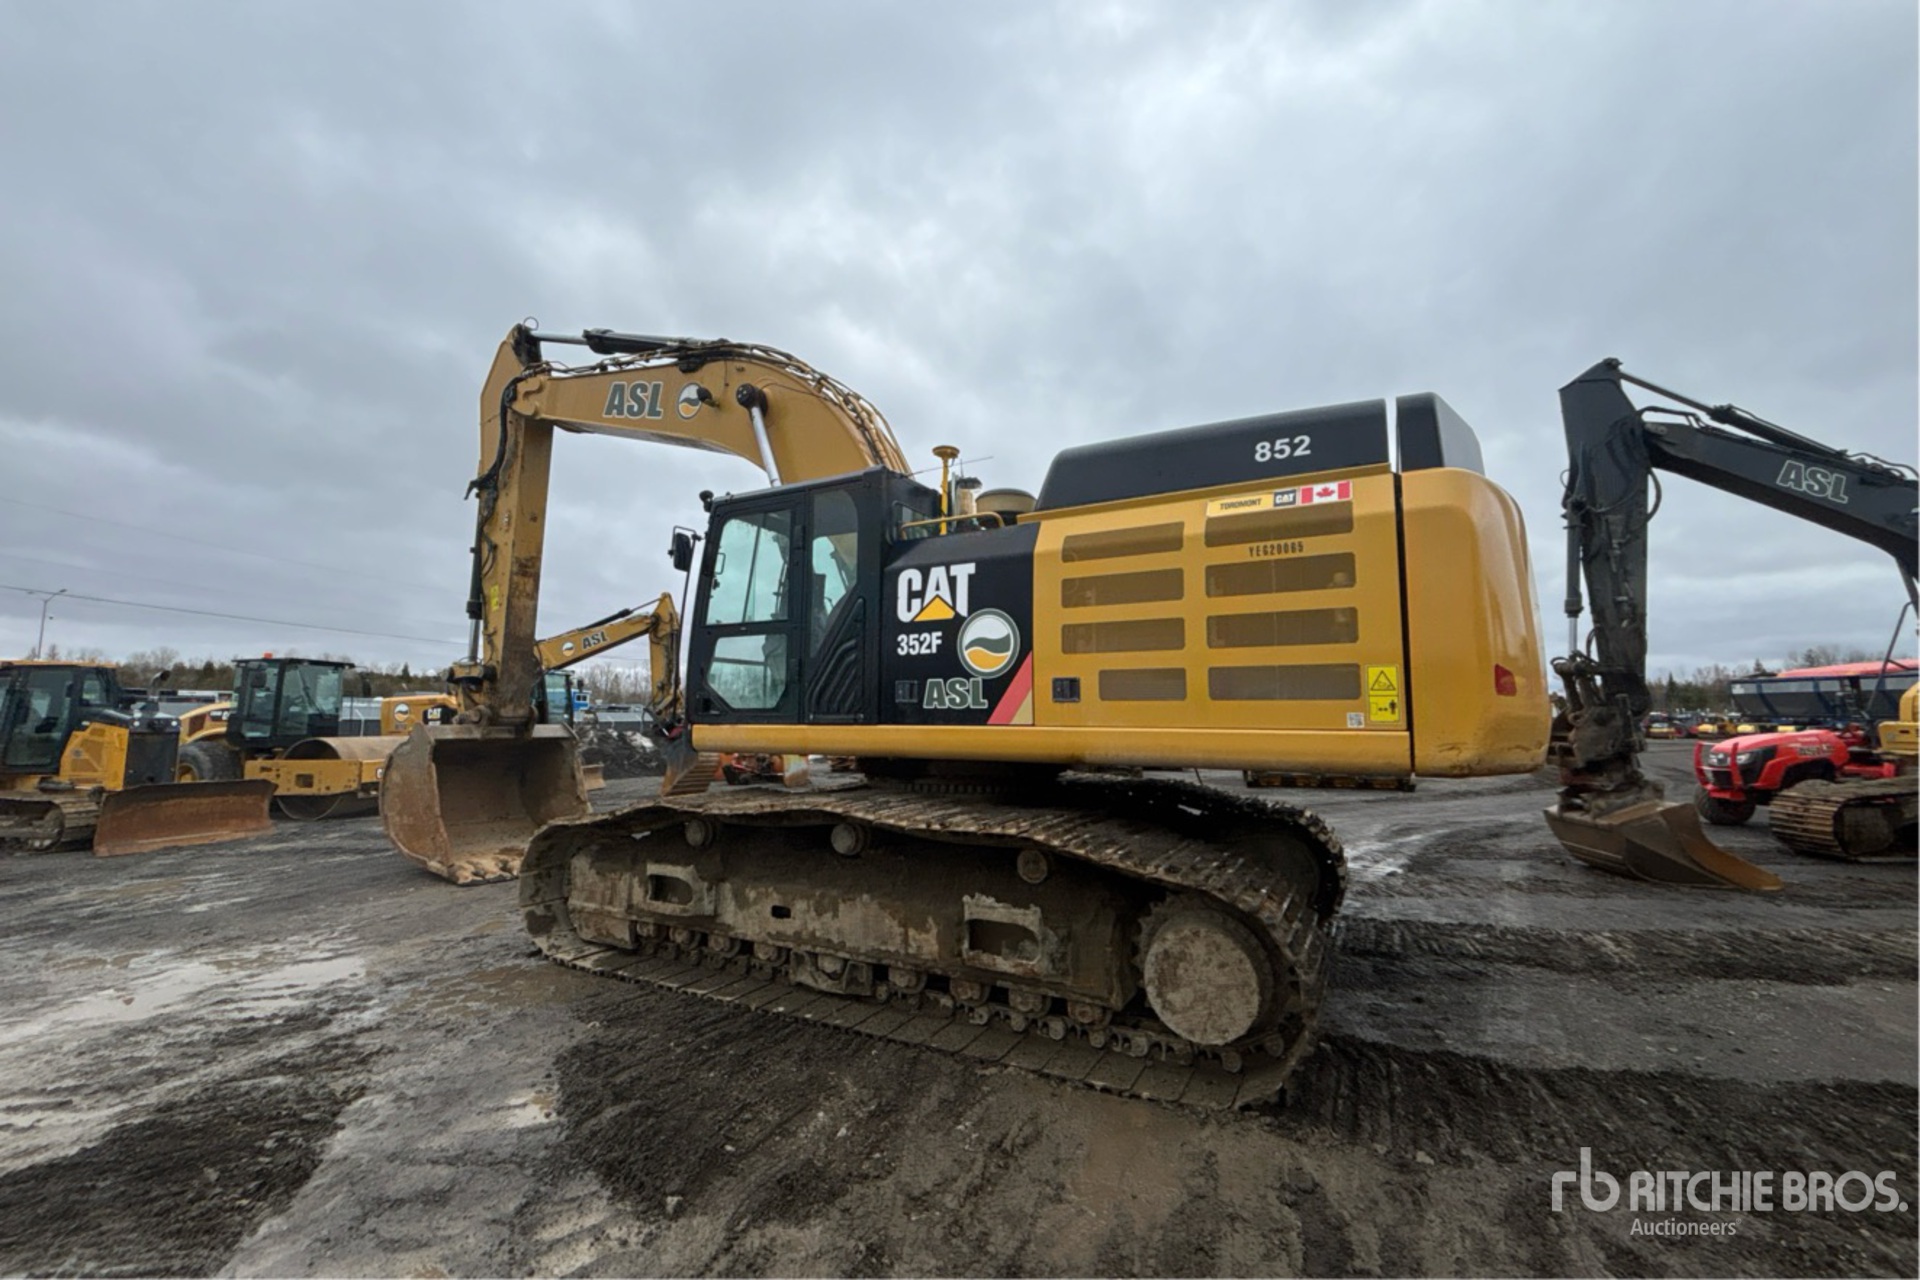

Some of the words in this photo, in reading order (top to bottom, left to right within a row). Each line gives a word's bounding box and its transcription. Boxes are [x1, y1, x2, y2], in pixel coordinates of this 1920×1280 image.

[602, 381, 664, 419] ASL
[1254, 434, 1312, 463] 852
[1776, 460, 1849, 504] ASL
[1219, 498, 1262, 511] TOROMONT
[1275, 492, 1296, 504] CAT
[896, 562, 977, 623] CAT
[581, 630, 609, 650] ASL
[897, 631, 943, 656] 352F
[922, 677, 989, 710] ASL
